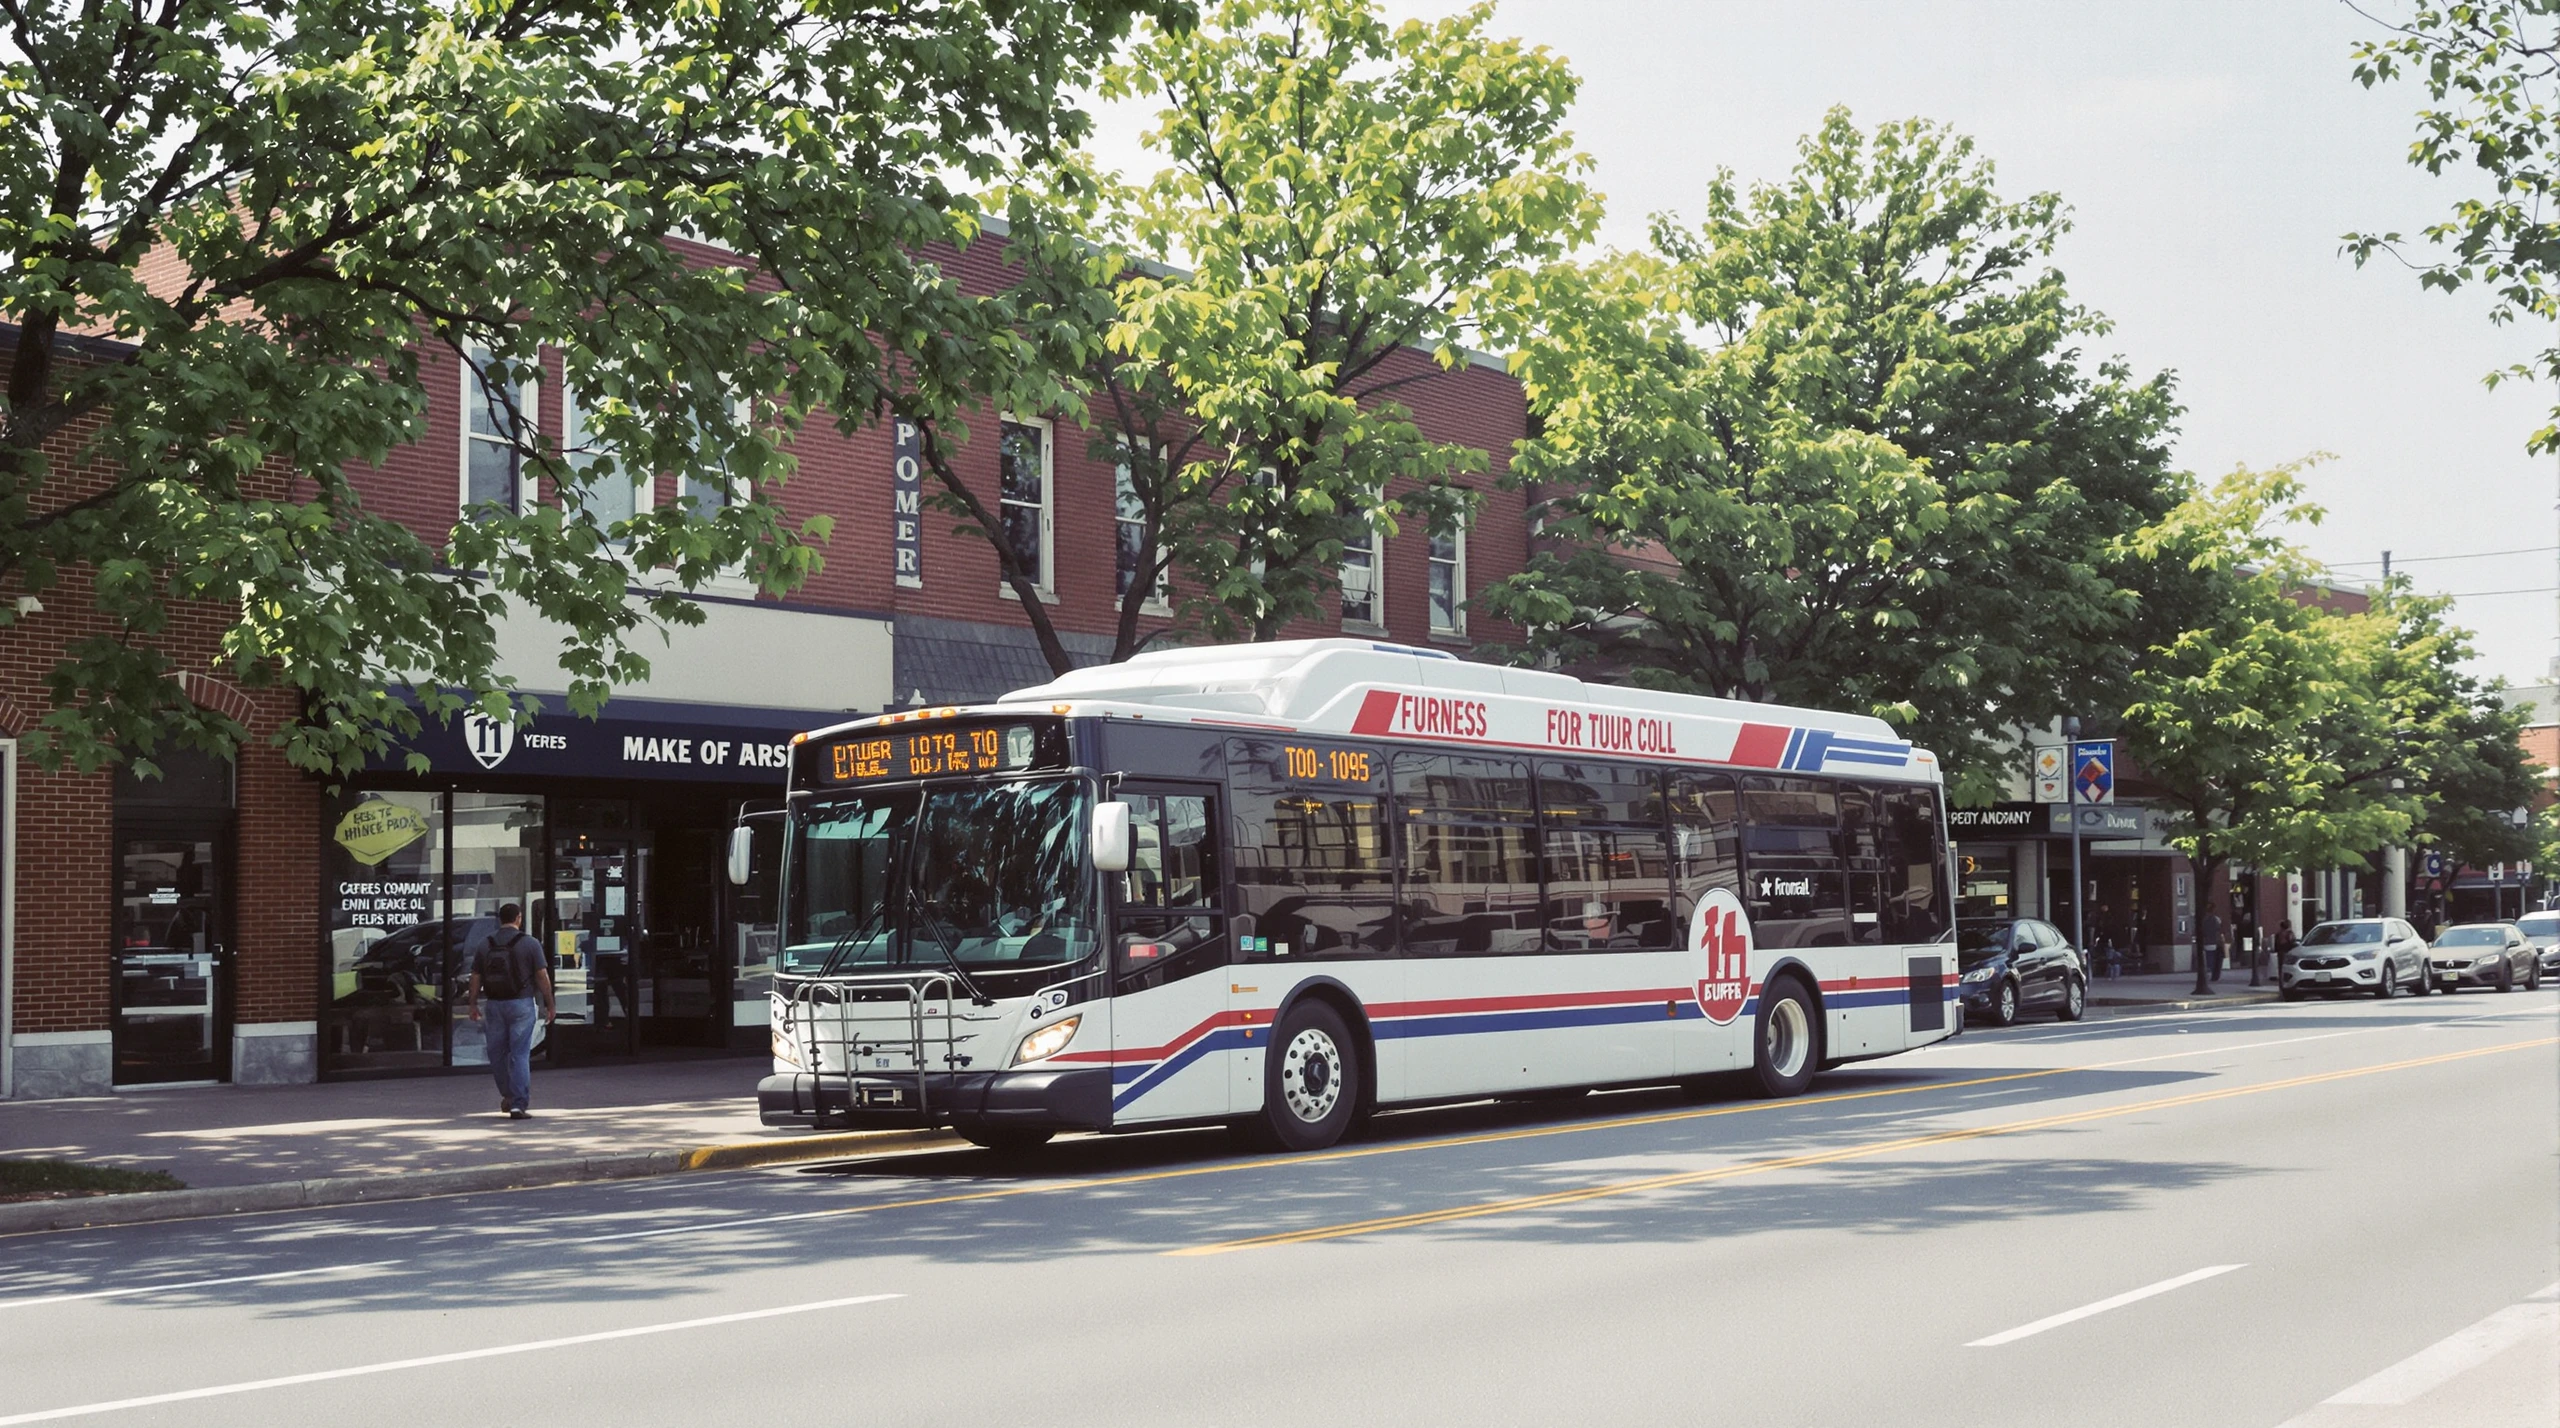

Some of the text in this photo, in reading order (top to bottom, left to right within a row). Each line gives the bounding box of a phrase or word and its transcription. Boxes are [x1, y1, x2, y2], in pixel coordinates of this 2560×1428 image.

[894, 423, 919, 572] POMER
[523, 733, 567, 750] YERES
[1402, 695, 1677, 754] FURNESS FOR TUUR COLL
[623, 735, 691, 764] MAKE
[700, 740, 730, 765] OF
